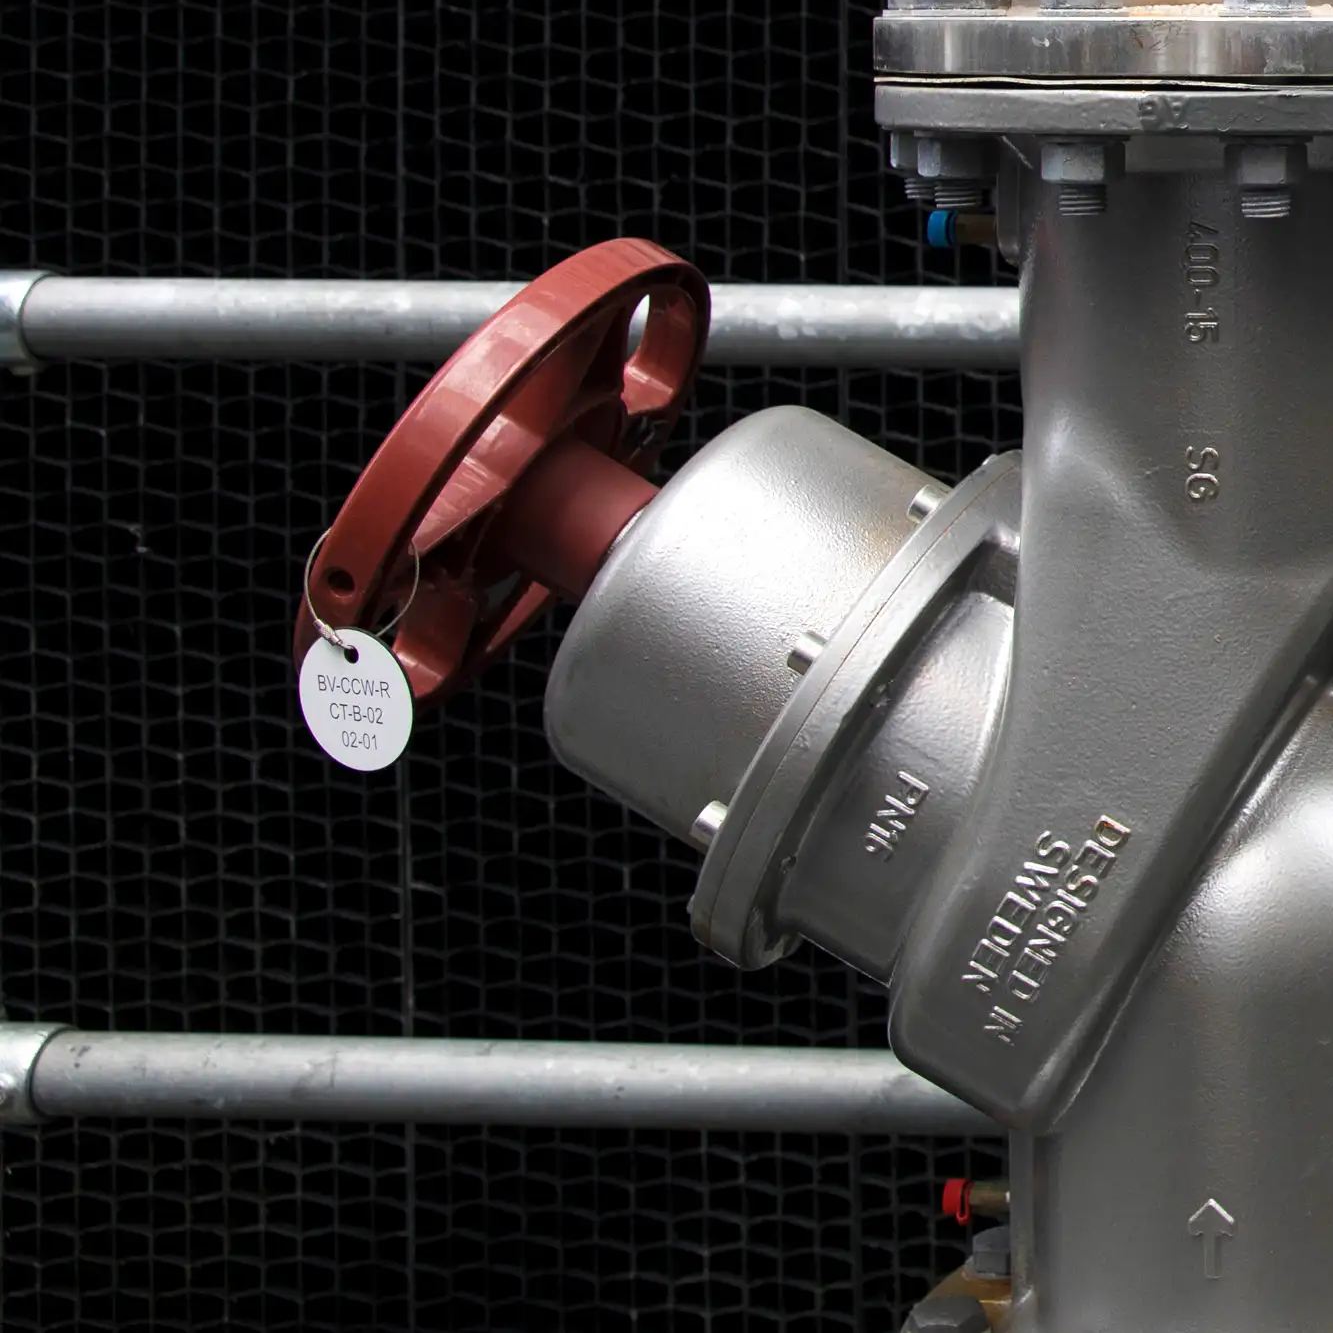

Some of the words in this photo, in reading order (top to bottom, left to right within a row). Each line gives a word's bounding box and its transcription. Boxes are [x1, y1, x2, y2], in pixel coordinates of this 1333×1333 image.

[317, 674, 391, 698] BV-CCW-R
[329, 703, 383, 725] CT-B-02
[341, 730, 378, 751] 02-01
[864, 770, 930, 864] PN16
[962, 830, 1072, 997] SWEDEN
[1007, 815, 1132, 1003] DESIGNED
